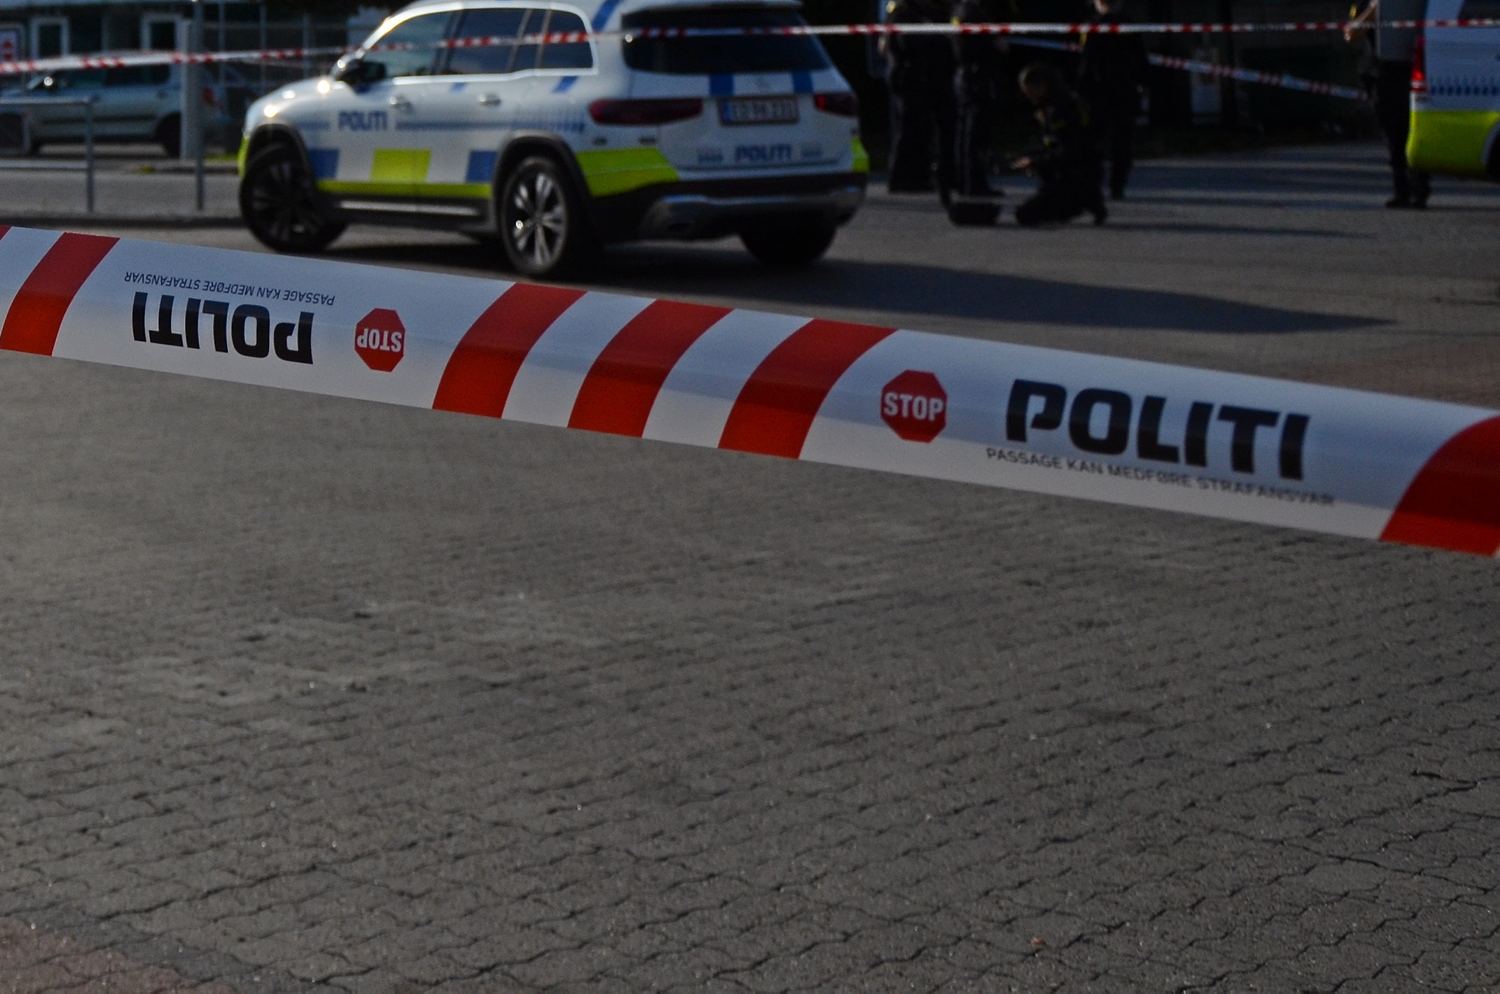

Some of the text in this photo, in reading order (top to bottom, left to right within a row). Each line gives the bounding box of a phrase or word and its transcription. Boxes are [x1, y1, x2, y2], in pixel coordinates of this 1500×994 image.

[338, 109, 388, 132] POLITI
[734, 143, 792, 162] POLITI
[123, 271, 336, 306] PASSAGE KAN MEDFØRE STRAFANSVAR
[131, 291, 315, 365] POLITI
[356, 328, 403, 353] STOP
[883, 391, 945, 422] STOP
[1005, 378, 1310, 482] POLITI
[986, 446, 1335, 507] PASSAGE KAN MEDFØRE STRAFANSVAR
